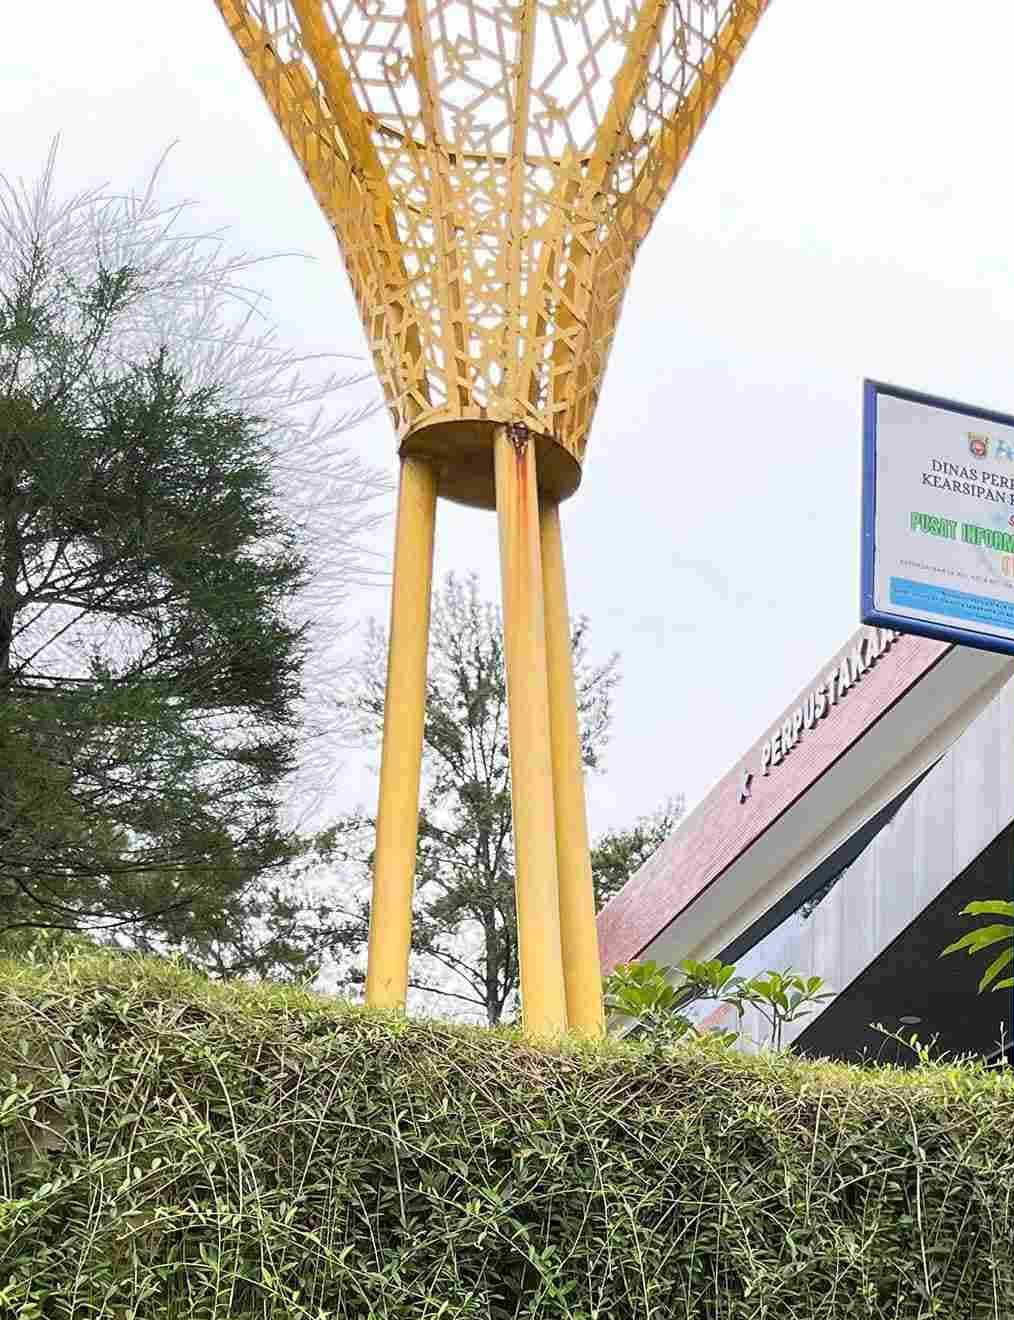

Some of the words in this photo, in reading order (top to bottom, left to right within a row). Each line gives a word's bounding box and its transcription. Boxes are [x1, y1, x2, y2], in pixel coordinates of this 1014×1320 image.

[931, 458, 978, 481] DINAS
[921, 472, 1006, 504] KEARSIPAN
[910, 511, 957, 540] PUSAT
[760, 628, 903, 776] PERPUSTAKA
